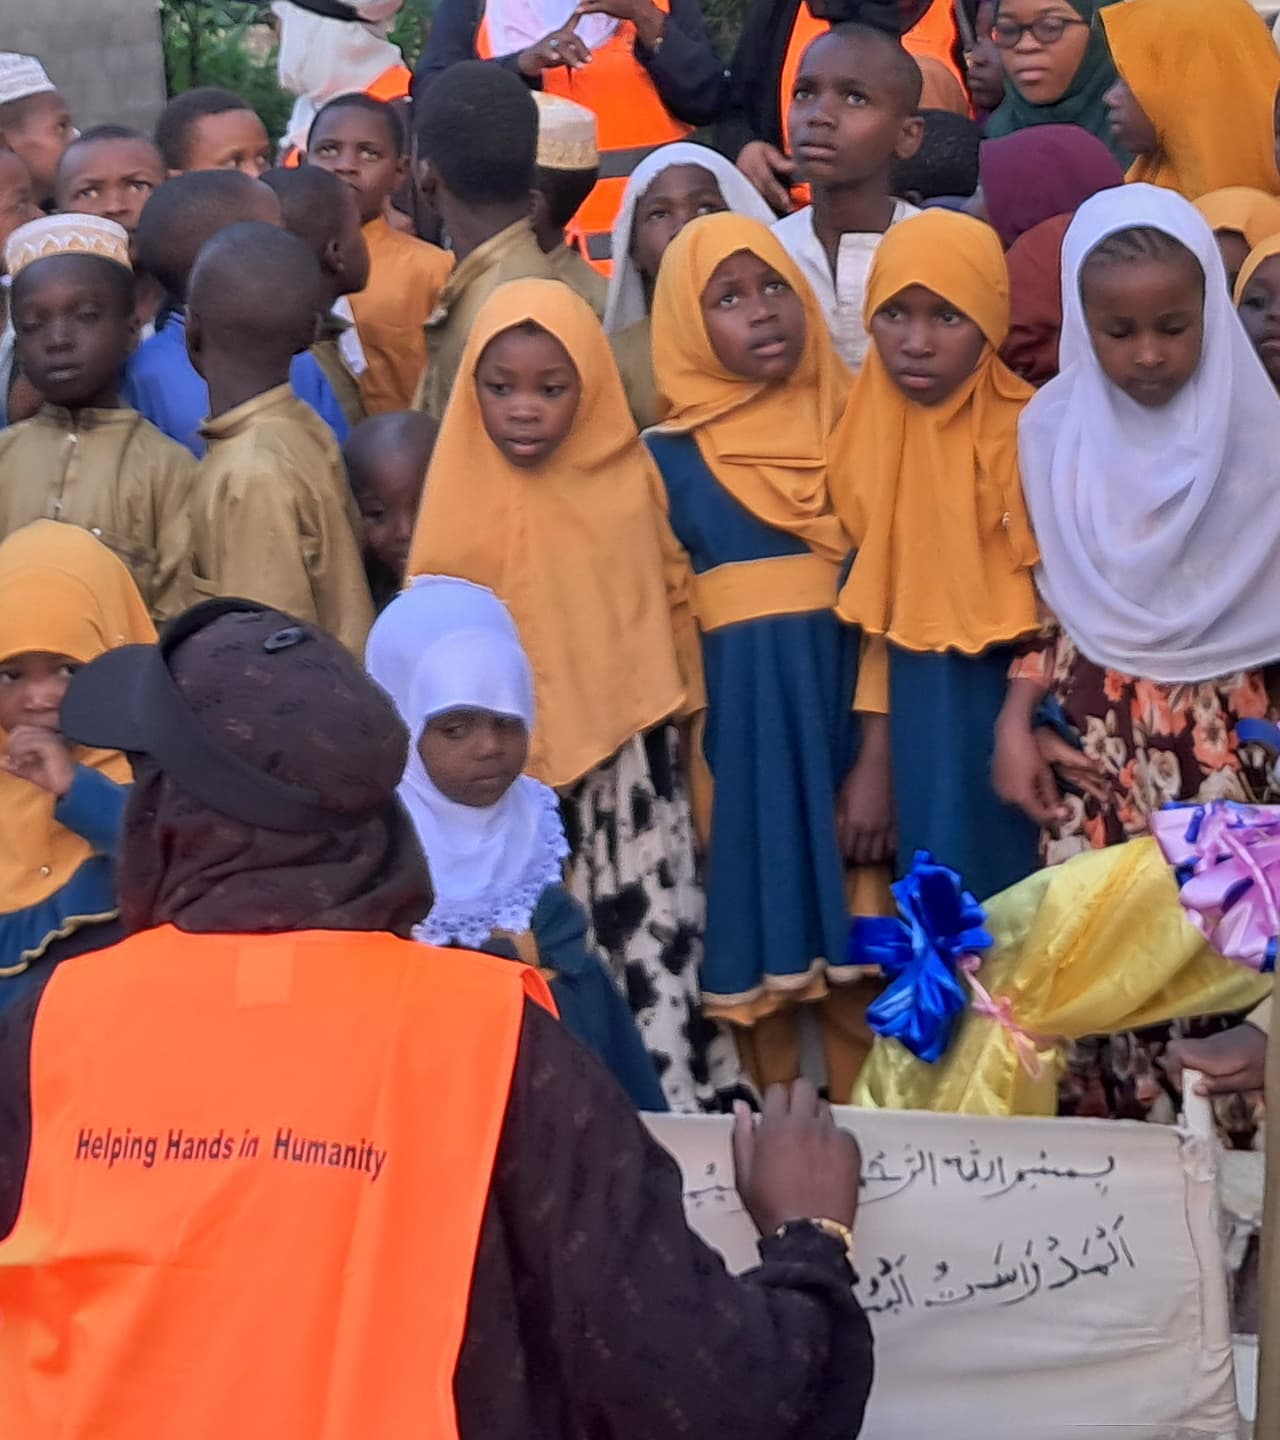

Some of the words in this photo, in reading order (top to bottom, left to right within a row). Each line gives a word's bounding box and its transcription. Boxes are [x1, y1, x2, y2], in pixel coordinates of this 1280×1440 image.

[75, 1127, 159, 1169] Helping
[164, 1128, 234, 1161] Hands
[238, 1128, 260, 1159] in
[273, 1127, 388, 1183] Humanity
